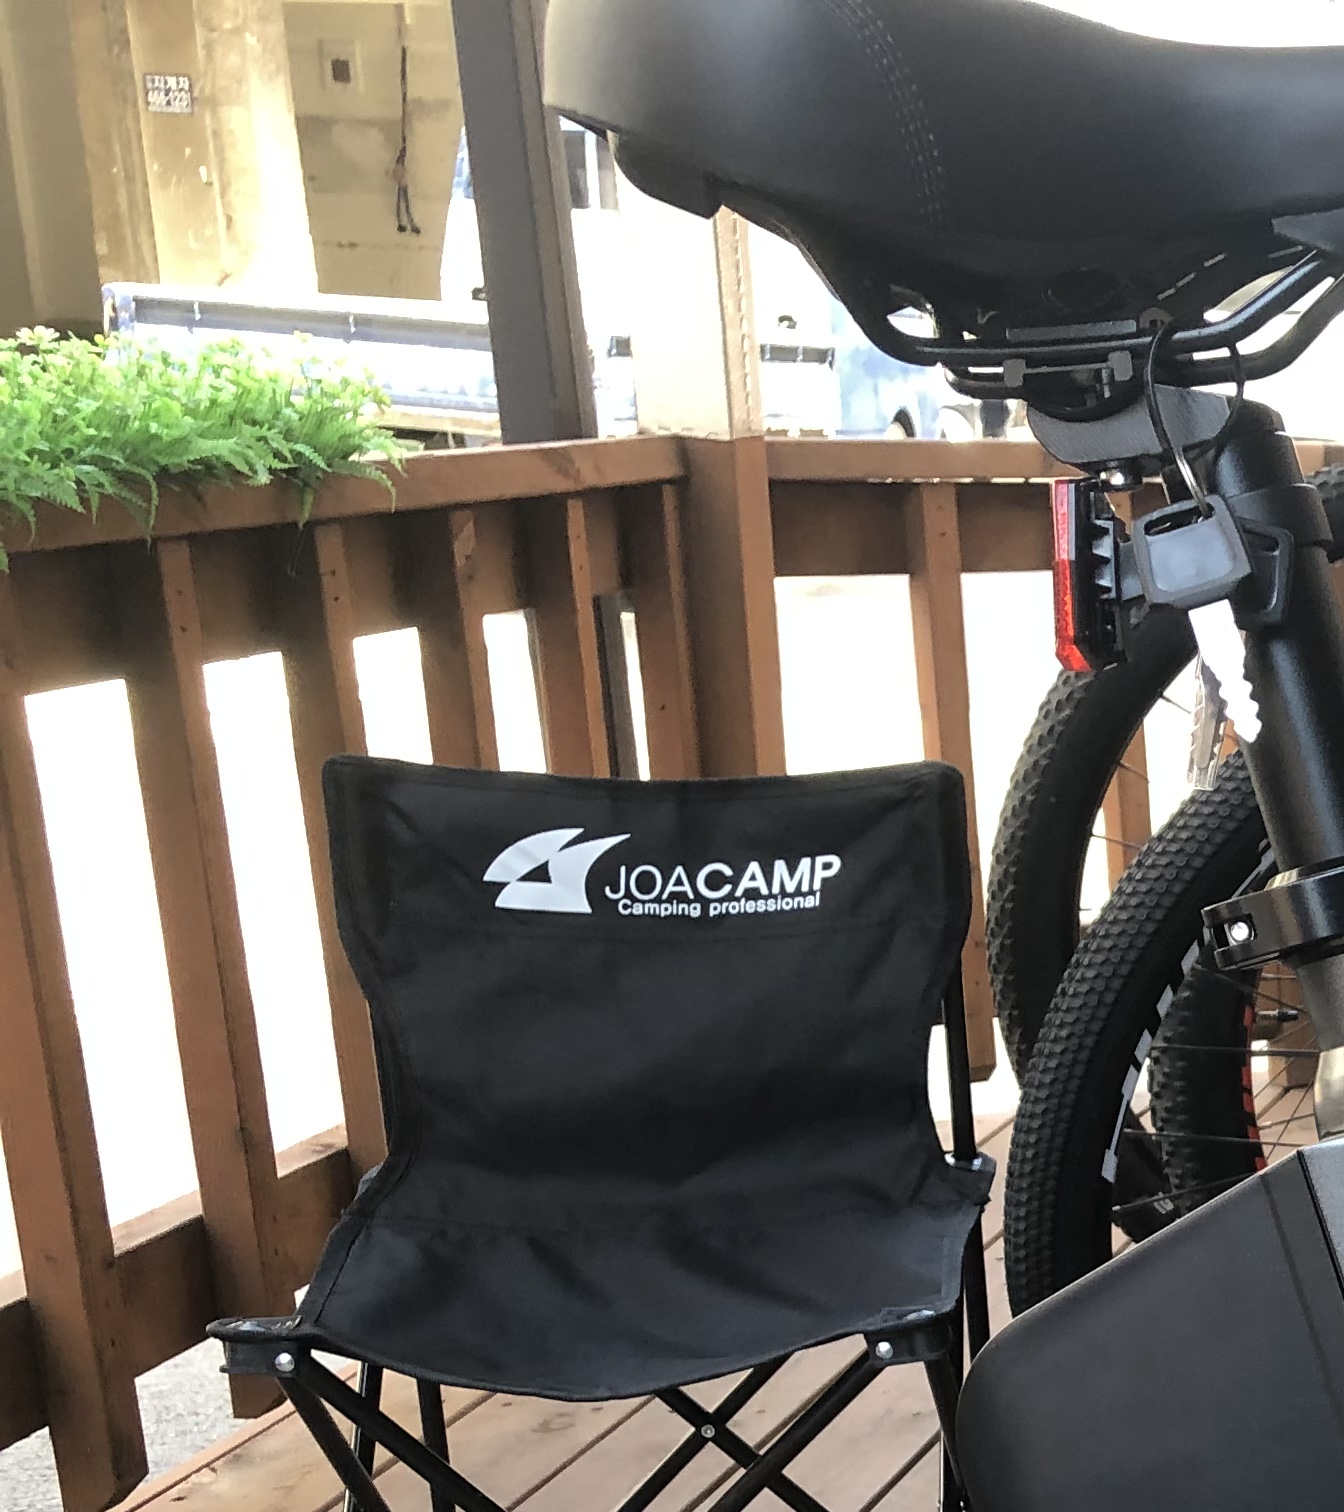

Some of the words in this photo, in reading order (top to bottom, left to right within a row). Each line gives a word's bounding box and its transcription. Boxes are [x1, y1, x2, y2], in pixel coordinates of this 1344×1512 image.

[604, 854, 842, 901] JOACAMP
[617, 899, 702, 919] Camping
[709, 891, 822, 918] professional
